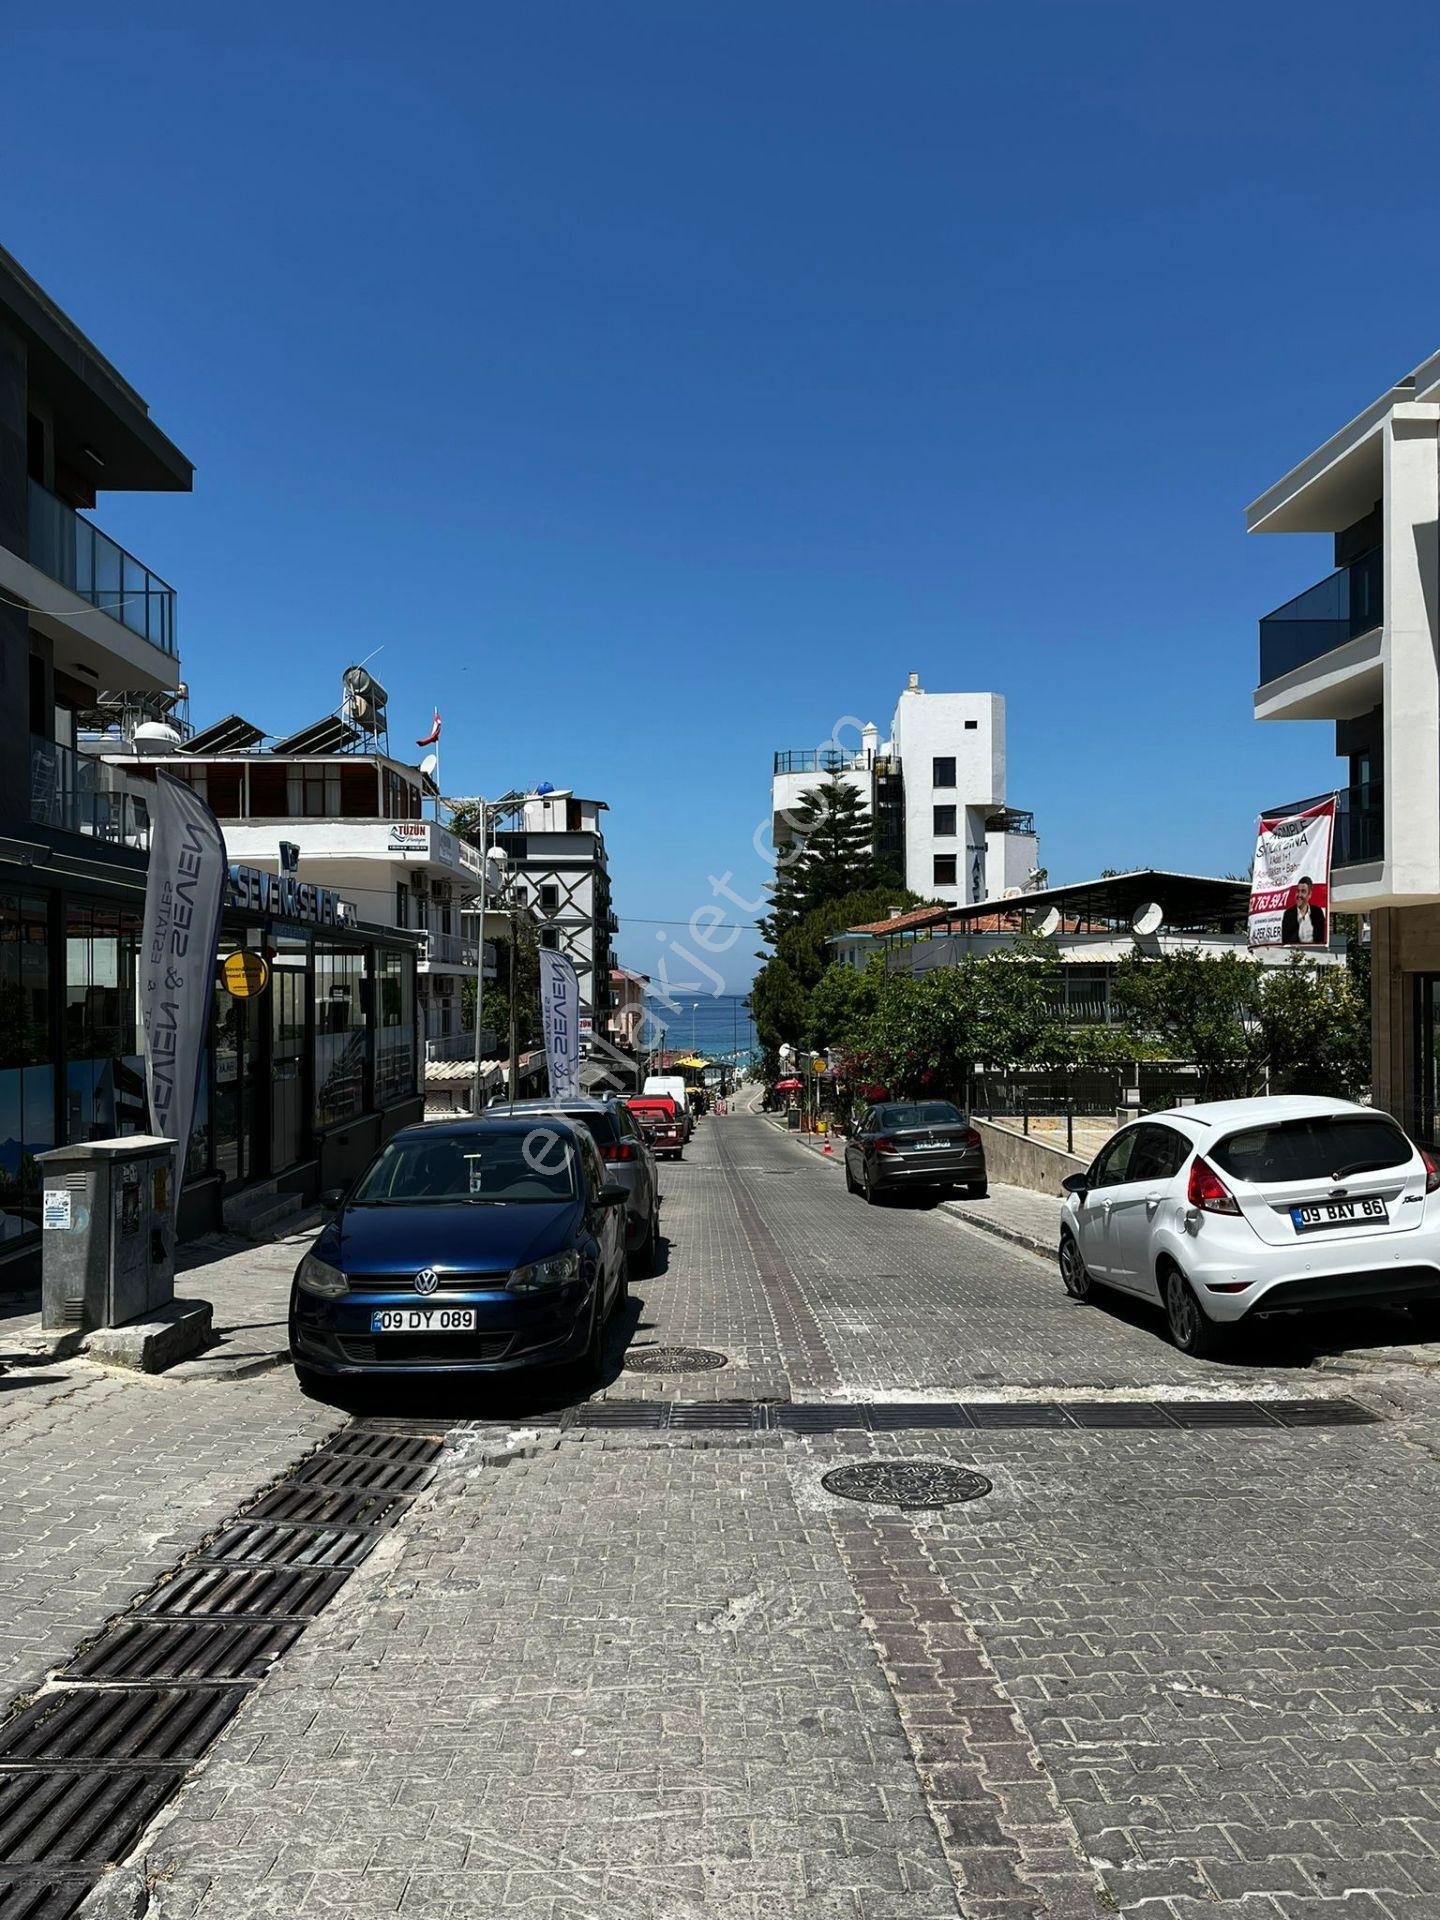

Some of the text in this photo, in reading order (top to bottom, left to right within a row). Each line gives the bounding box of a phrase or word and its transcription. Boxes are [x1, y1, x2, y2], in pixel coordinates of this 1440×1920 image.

[398, 823, 425, 835] TÜZÜN
[1302, 1200, 1383, 1223] 09 BAV 86
[382, 1312, 402, 1328] 09
[409, 1311, 434, 1328] DY
[440, 1311, 472, 1328] 089
